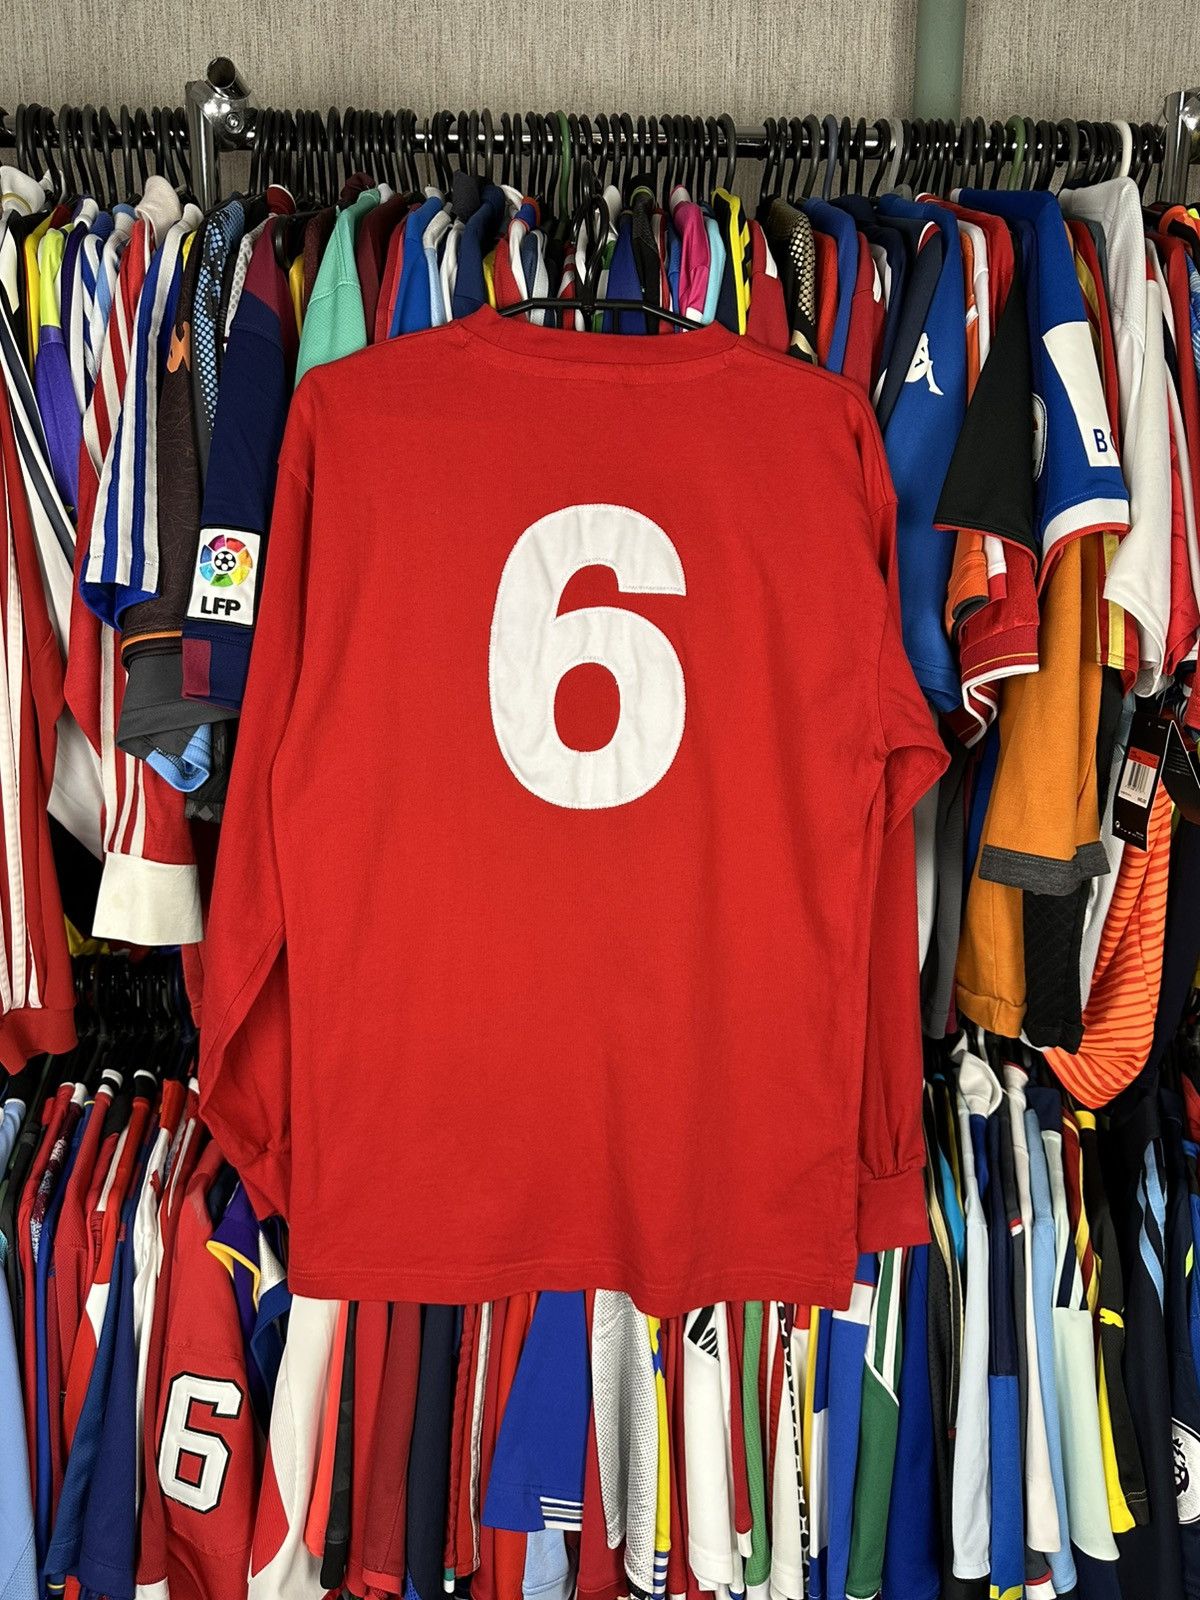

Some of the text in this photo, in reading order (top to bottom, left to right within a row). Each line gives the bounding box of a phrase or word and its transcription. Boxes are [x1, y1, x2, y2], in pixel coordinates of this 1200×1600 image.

[1093, 428, 1117, 453] B
[201, 595, 241, 616] LFP
[488, 503, 687, 810] 6
[156, 1370, 245, 1515] 6
